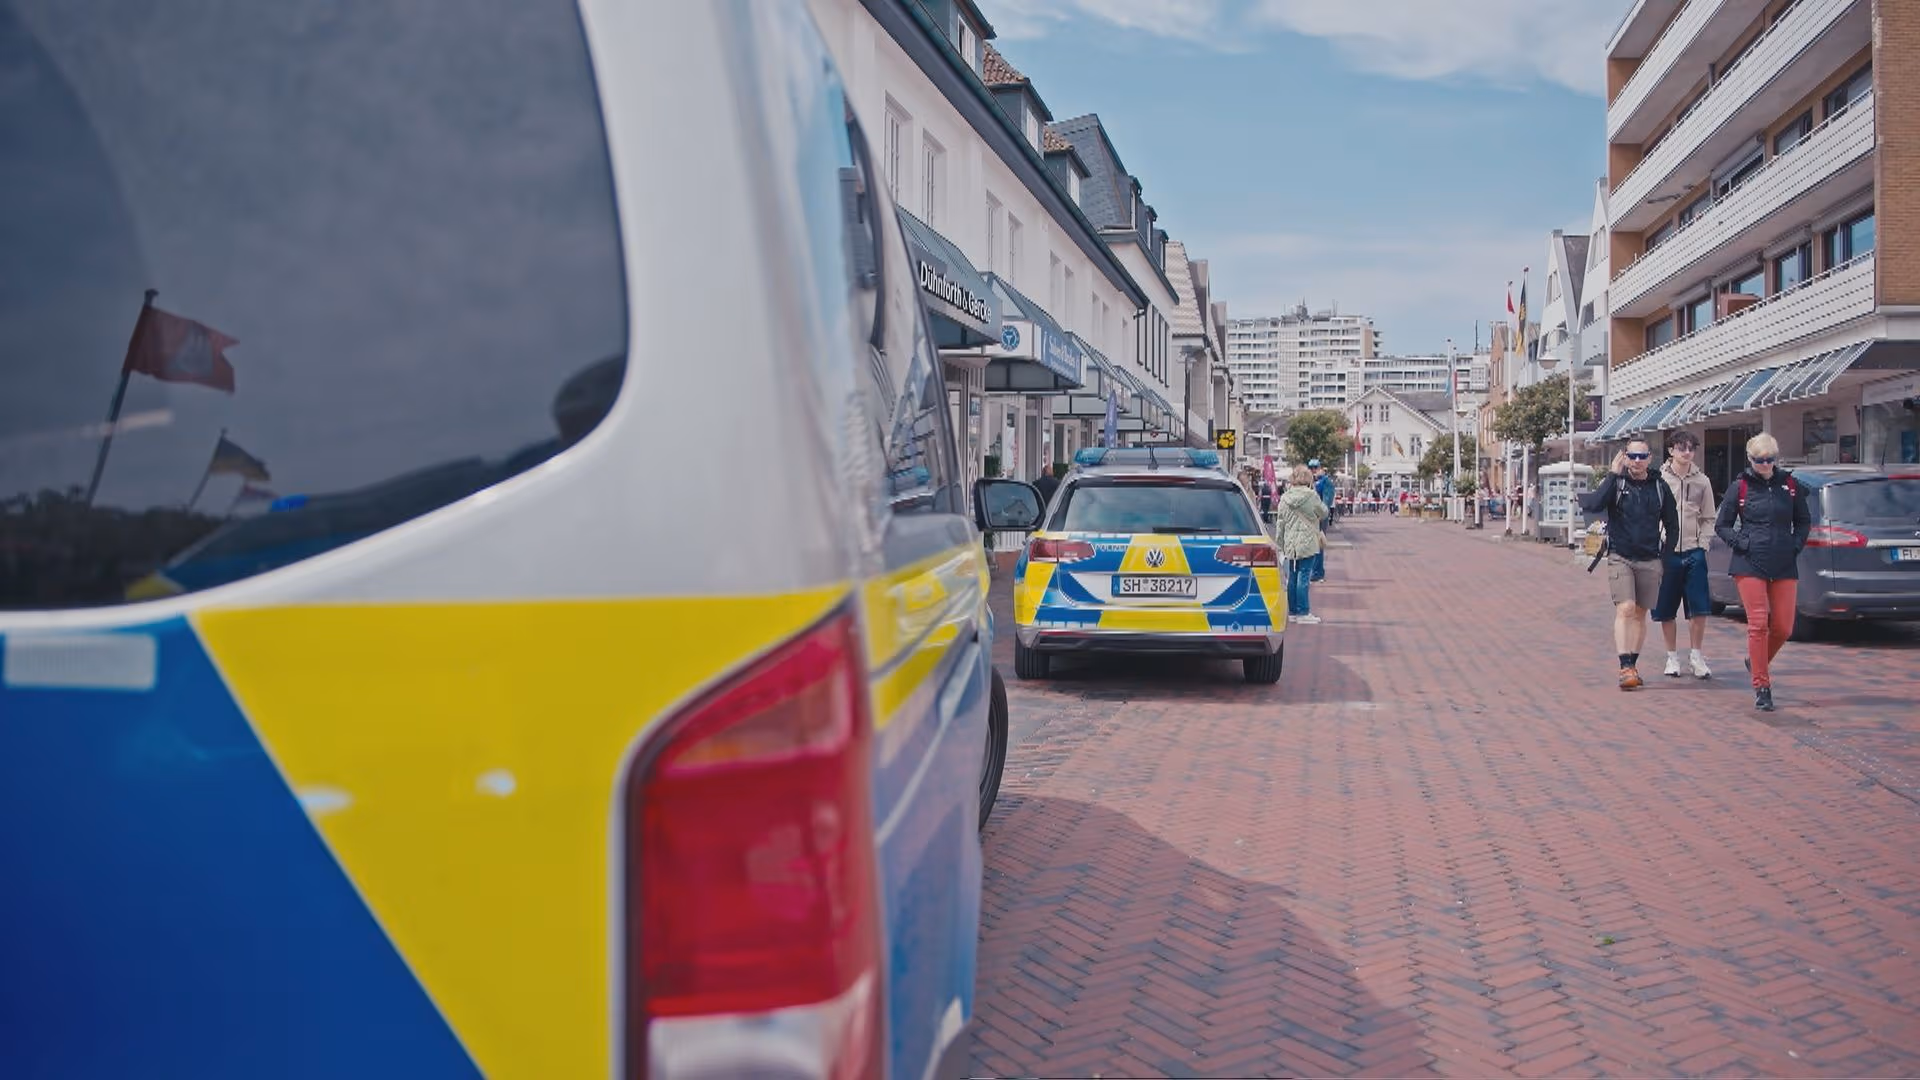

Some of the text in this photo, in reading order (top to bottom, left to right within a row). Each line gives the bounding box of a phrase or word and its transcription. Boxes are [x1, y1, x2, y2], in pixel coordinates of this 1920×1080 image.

[920, 260, 962, 307] Dühnforth
[962, 288, 968, 310] &
[1122, 578, 1193, 593] SH 38217
